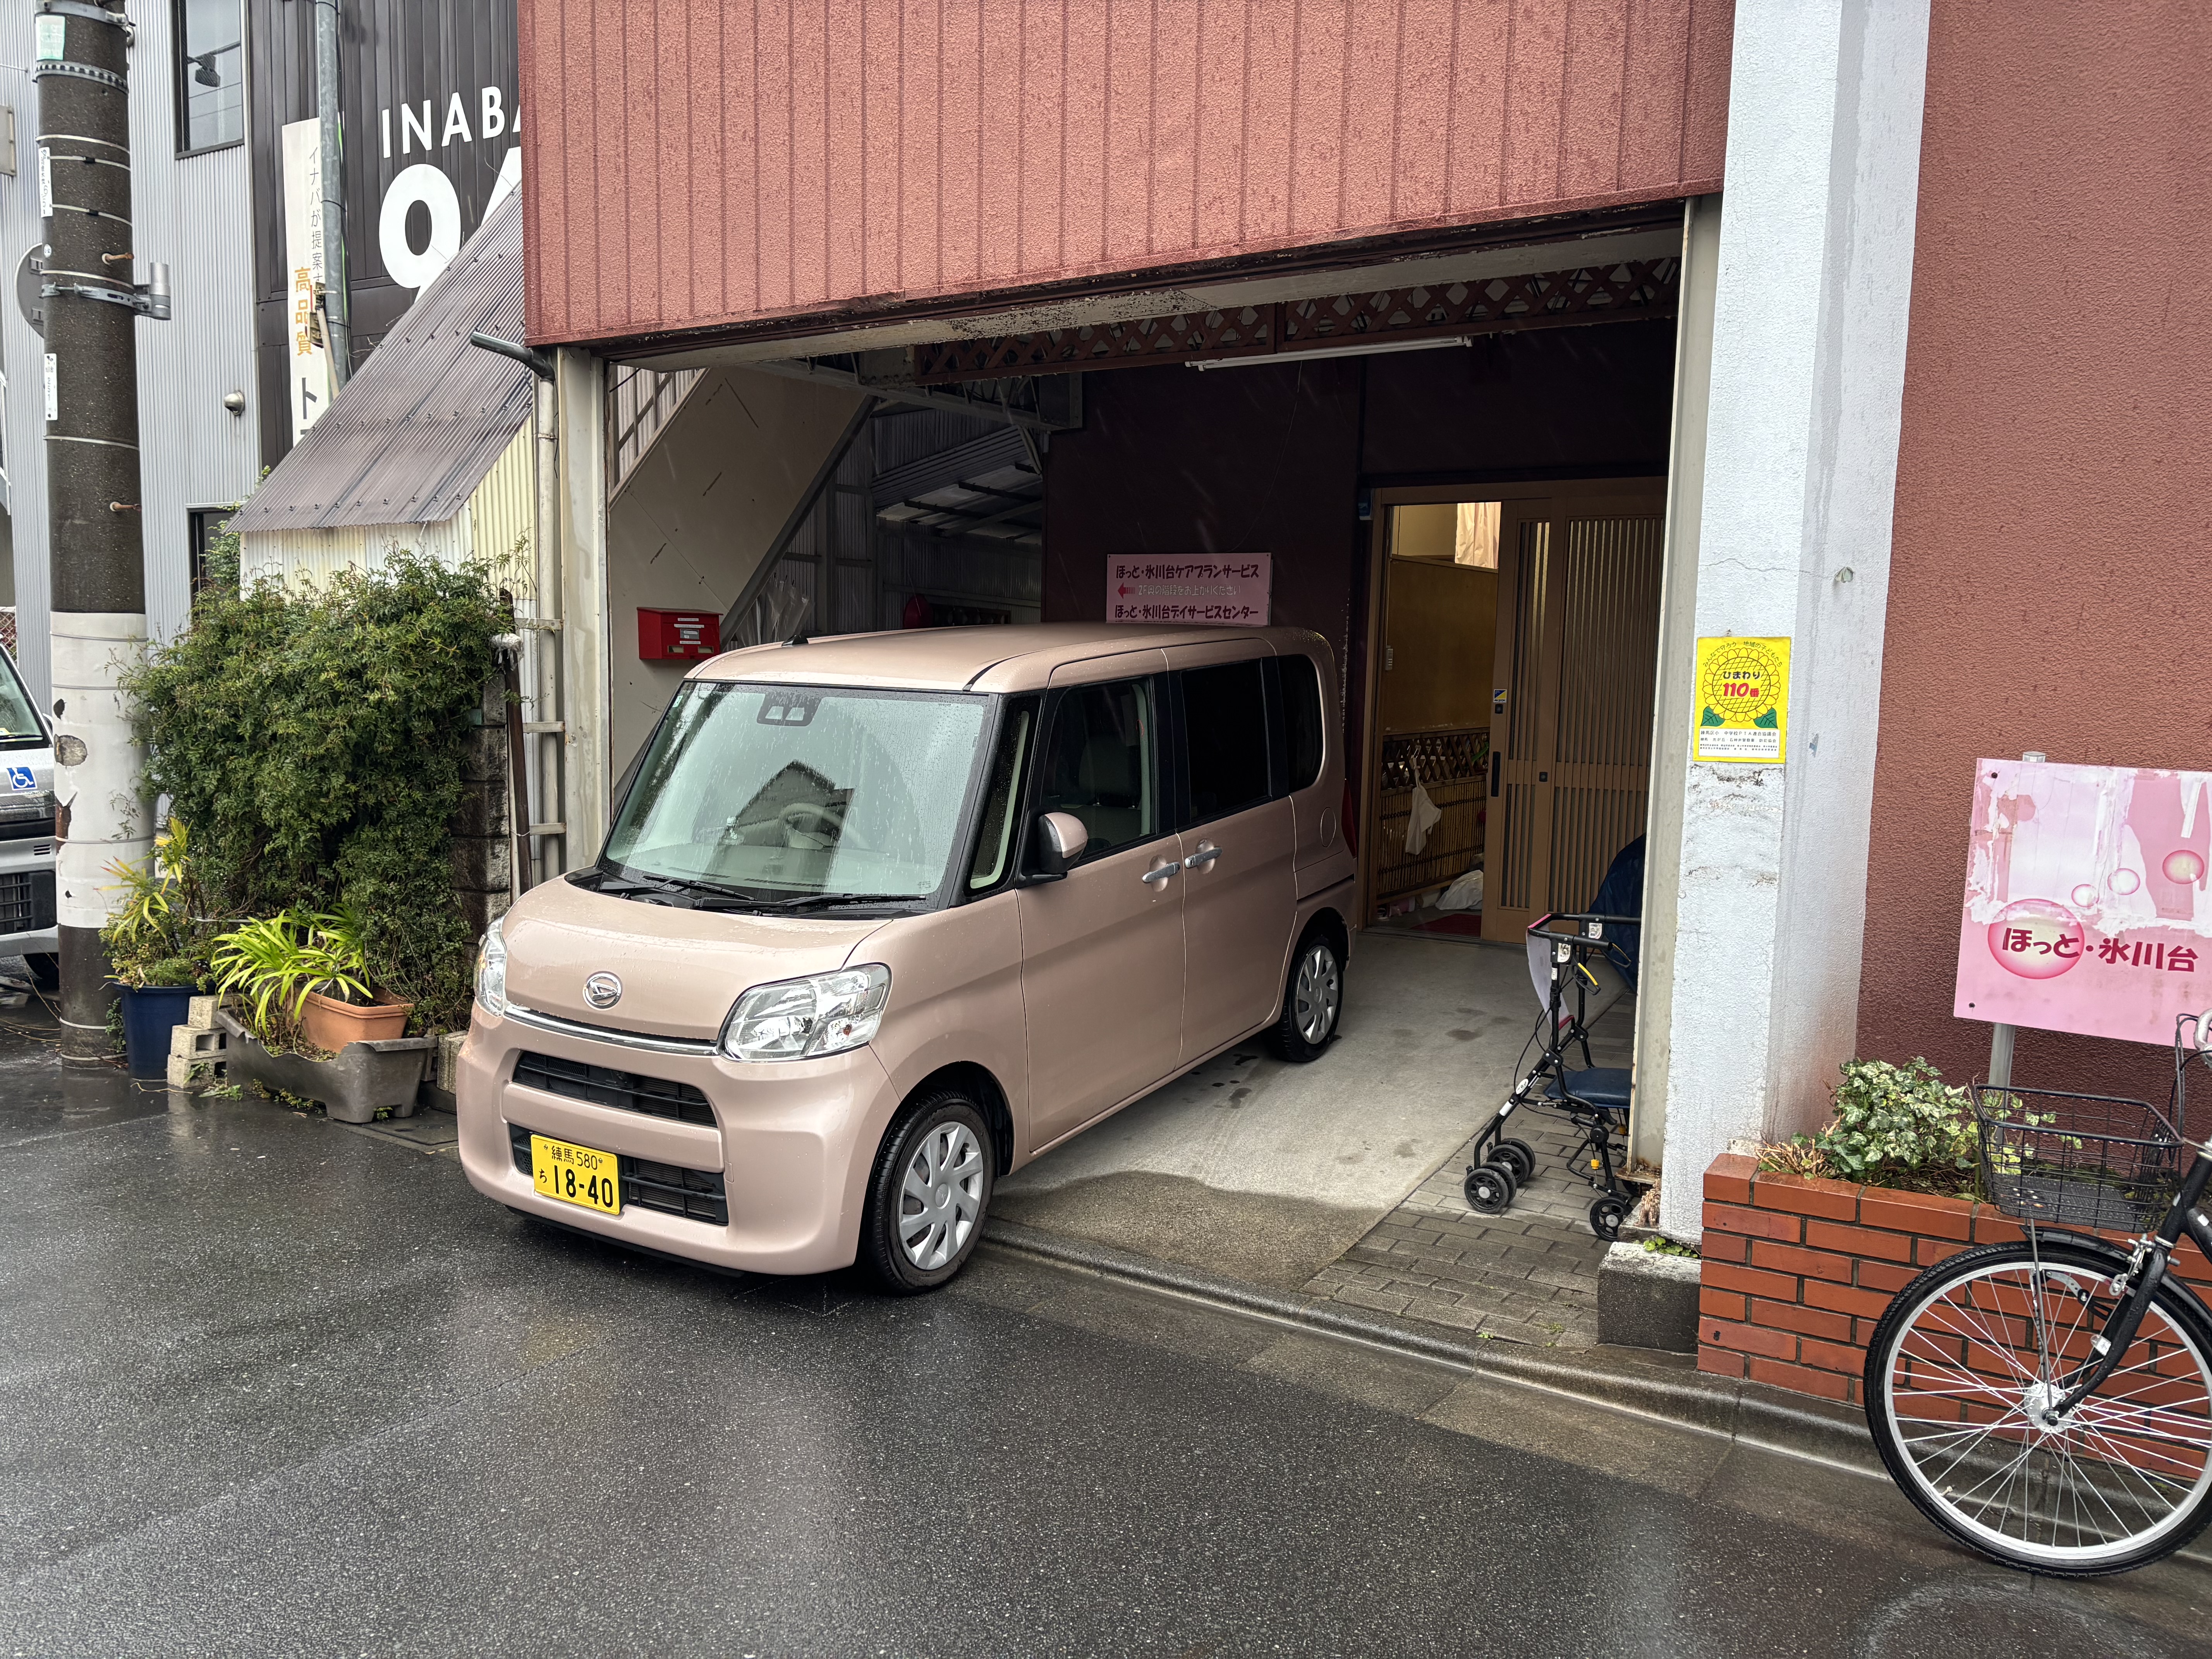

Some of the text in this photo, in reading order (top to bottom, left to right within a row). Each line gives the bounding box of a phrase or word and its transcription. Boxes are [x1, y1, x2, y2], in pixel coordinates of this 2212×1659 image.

[381, 86, 520, 158] INAB
[1116, 564, 1259, 579] ほっと・氷川台ケアプランサービス
[1115, 604, 1258, 619] ほっと・氷川台デイサービスセンター
[1723, 671, 1761, 680] ひまわり
[1723, 683, 1760, 697] 110番
[2002, 927, 2199, 972] ほっと・氷川台
[551, 1145, 598, 1170] 練馬 580
[539, 1165, 613, 1208] ち 18-40
